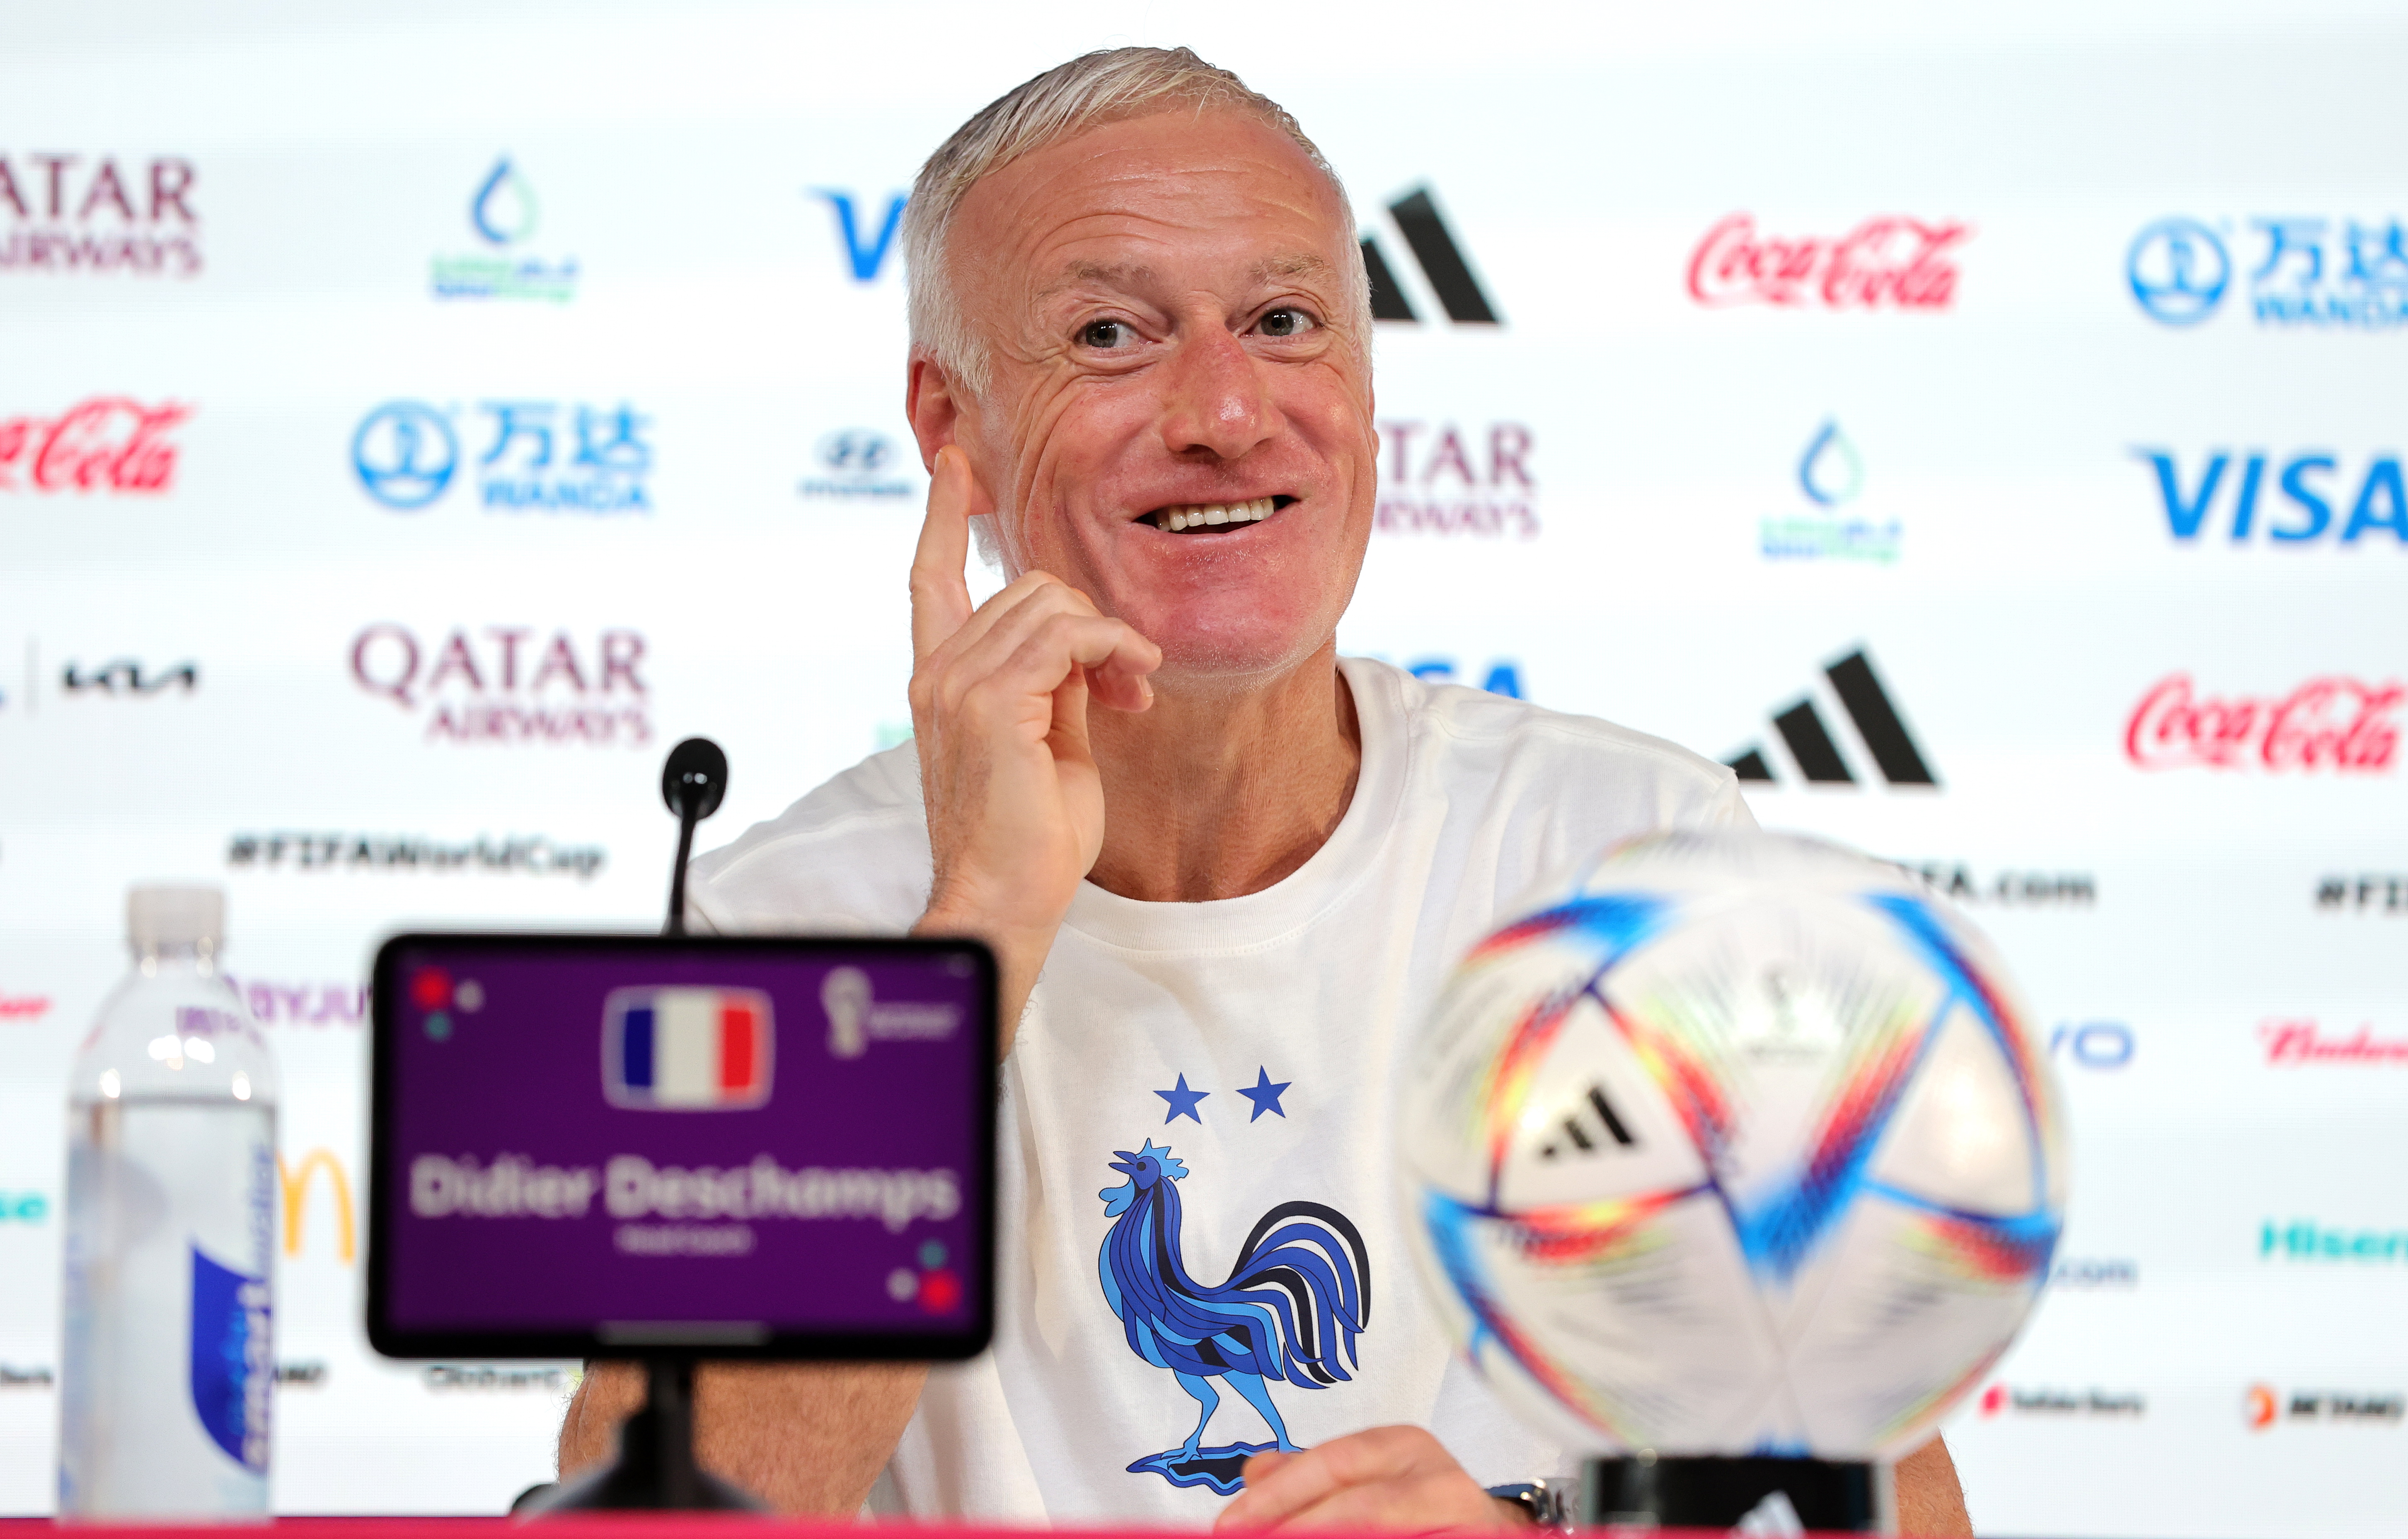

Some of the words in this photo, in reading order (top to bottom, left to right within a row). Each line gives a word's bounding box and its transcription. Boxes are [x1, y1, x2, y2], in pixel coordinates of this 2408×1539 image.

[477, 400, 654, 475] 万达
[479, 481, 652, 514] WANDA
[2130, 446, 2408, 546] VISA
[347, 624, 650, 710] QATAR
[427, 707, 653, 744] AIRWAYS
[225, 833, 610, 884] #FIFAWorldCup
[410, 1152, 599, 1219] Didier
[604, 1152, 961, 1232] Deschamps
